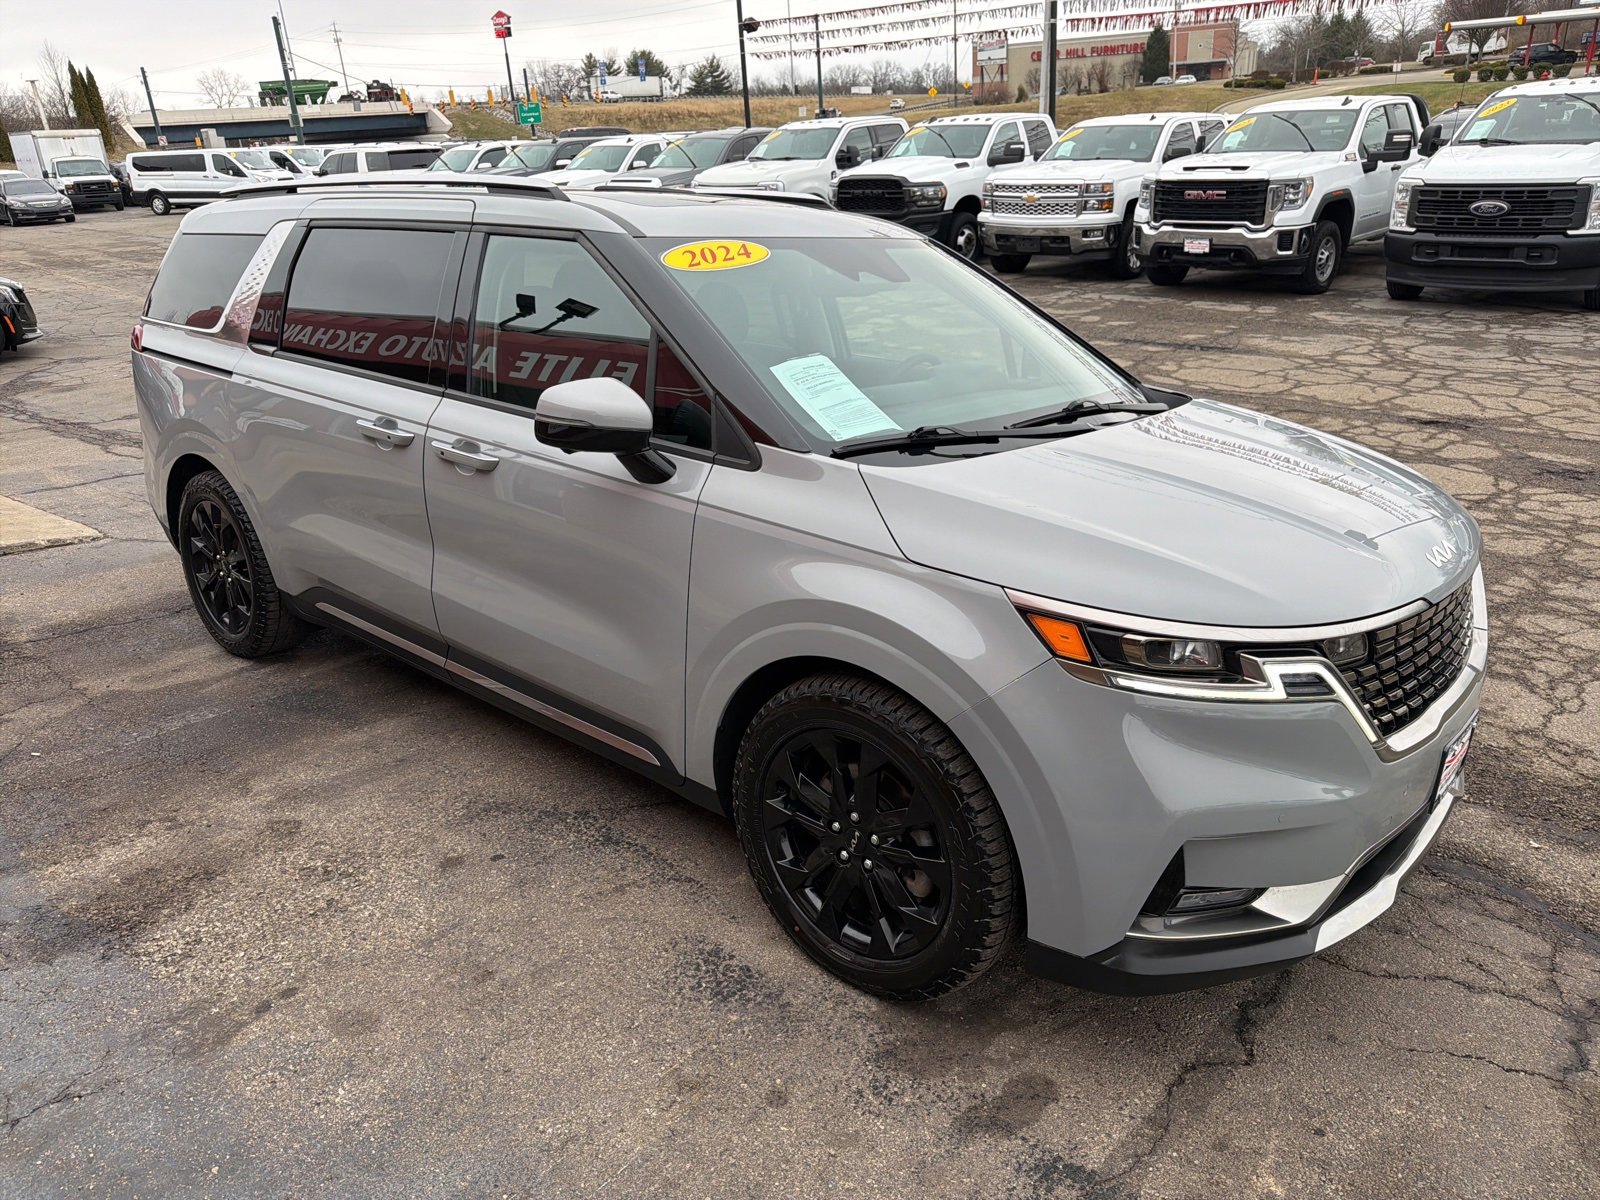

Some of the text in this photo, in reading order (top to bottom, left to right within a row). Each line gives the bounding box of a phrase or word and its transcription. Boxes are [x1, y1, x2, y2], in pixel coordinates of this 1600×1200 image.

[1031, 42, 1146, 62] CER HILL FURNITURE
[1184, 190, 1227, 200] GMC
[682, 243, 752, 268] 2024
